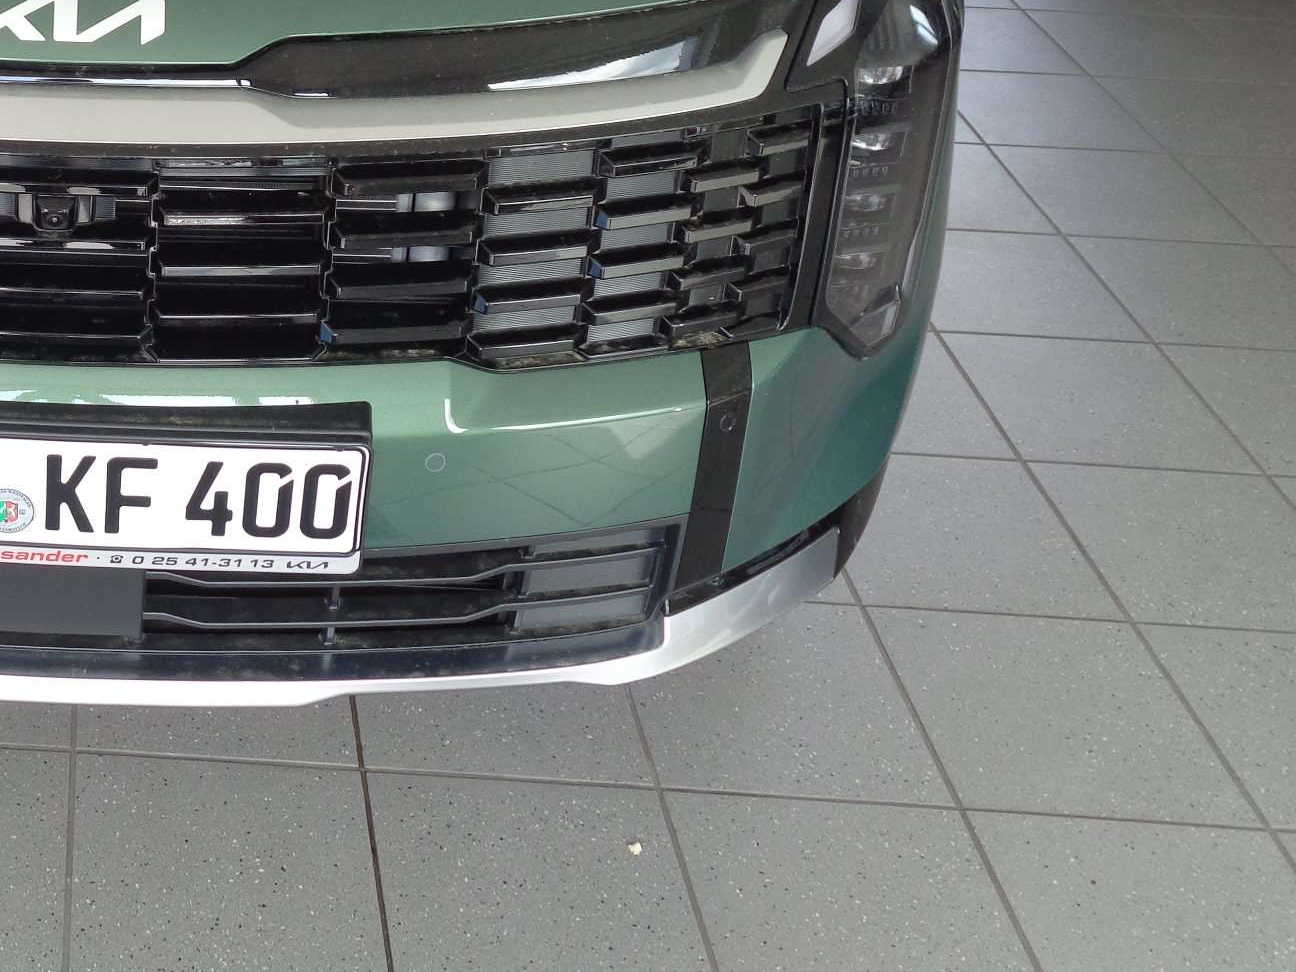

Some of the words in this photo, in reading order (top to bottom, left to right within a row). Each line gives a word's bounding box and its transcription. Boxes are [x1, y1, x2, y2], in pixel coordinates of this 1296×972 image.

[45, 455, 158, 533] KF
[185, 461, 351, 538] 400
[151, 556, 178, 566] 25
[185, 557, 241, 568] 41-31
[252, 559, 274, 569] 13
[286, 561, 329, 570] KIA
